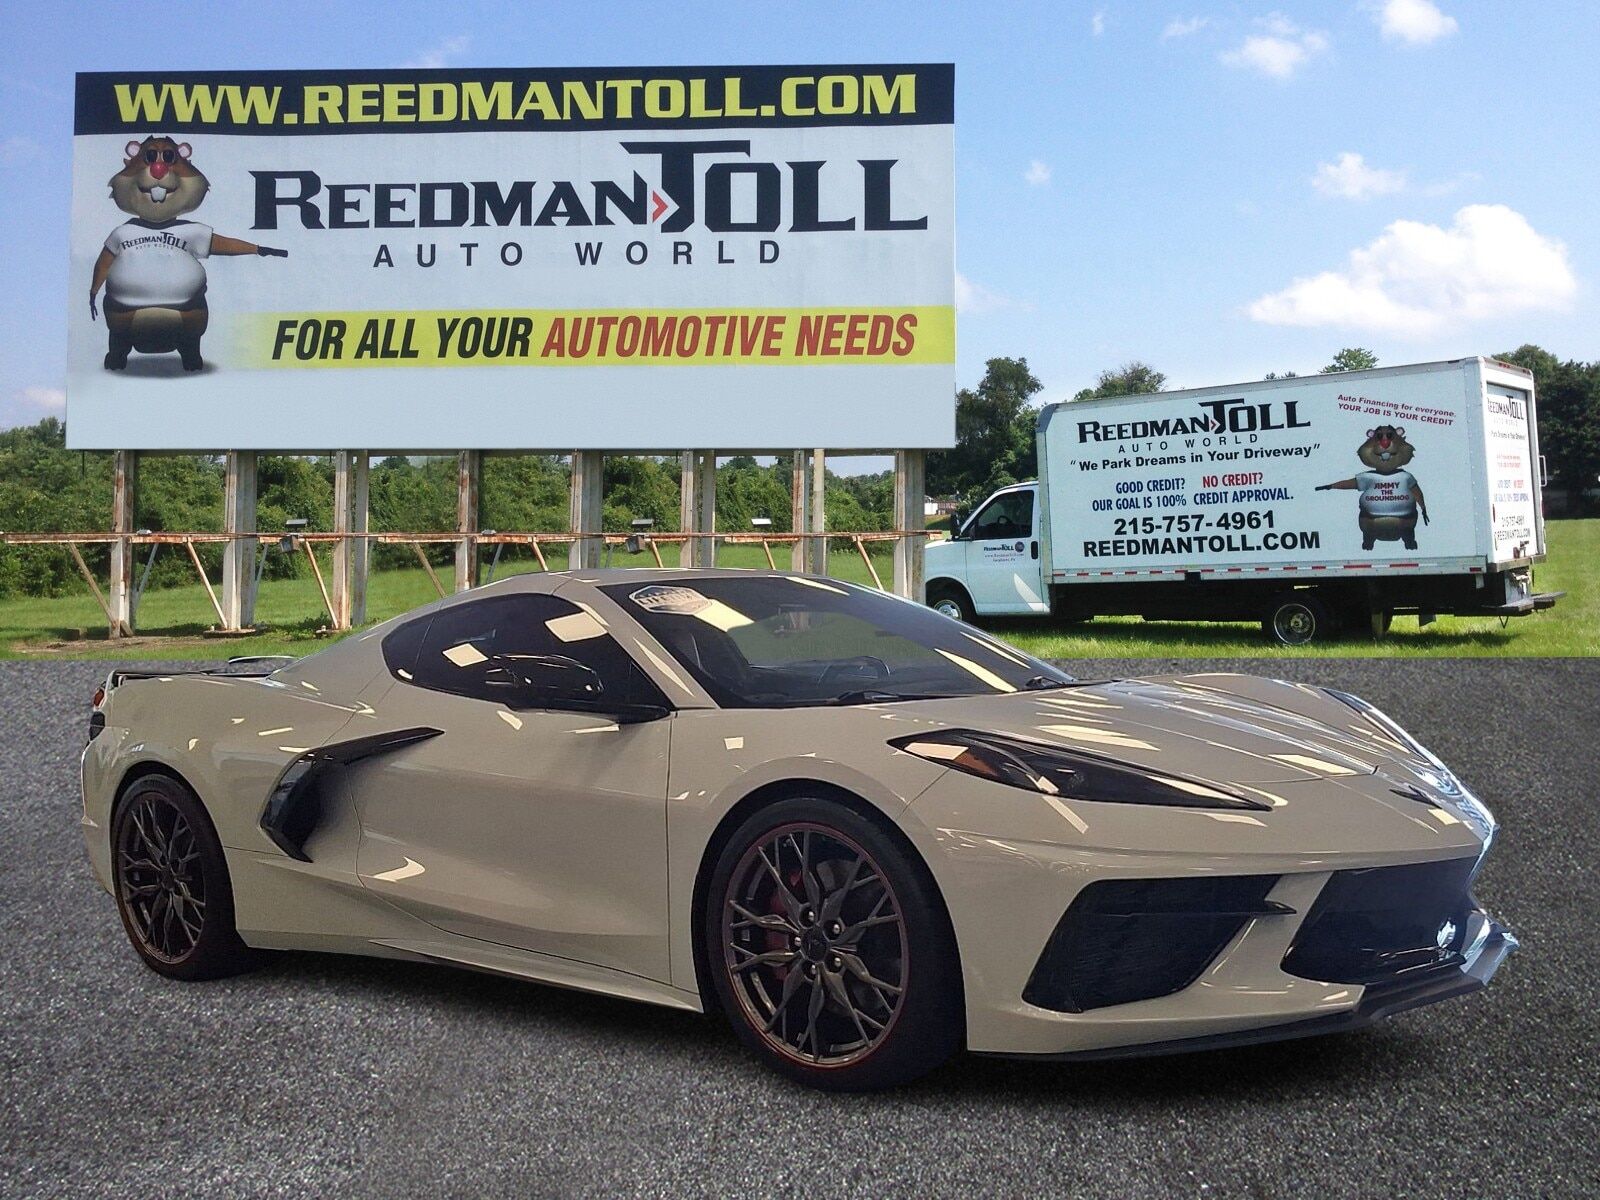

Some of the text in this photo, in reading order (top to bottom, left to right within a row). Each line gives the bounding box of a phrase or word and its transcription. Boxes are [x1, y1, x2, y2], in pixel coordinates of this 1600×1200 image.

[114, 73, 917, 124] WWW.REEDMANTOLL.COM
[373, 240, 781, 268] AUTO WORLD
[272, 313, 918, 361] FOR ALL YOUR AUTOMOTIVE NEEDS
[1338, 394, 1356, 403] Auto
[1359, 397, 1399, 410] Financing
[1401, 403, 1413, 411] for
[1338, 403, 1361, 412] YOUR
[1364, 407, 1380, 415] JOB
[1394, 412, 1419, 421] YOUR
[1420, 415, 1454, 426] CREDIT
[1118, 434, 1258, 453] AUTO WORLD
[1102, 458, 1132, 470] Park
[1136, 455, 1186, 467] Dreams
[1190, 452, 1203, 462] in
[1208, 451, 1240, 462] Your
[1116, 472, 1263, 494] GOOD CREDIT? NO CREDIT?
[1092, 488, 1294, 512] OUR GOAL IS 100% CREDIT APPROVAL.
[1365, 494, 1410, 502] GROUNDHOG
[1114, 510, 1275, 536] 215-757-4961
[1083, 531, 1320, 558] REEDMANTOLL.COM
